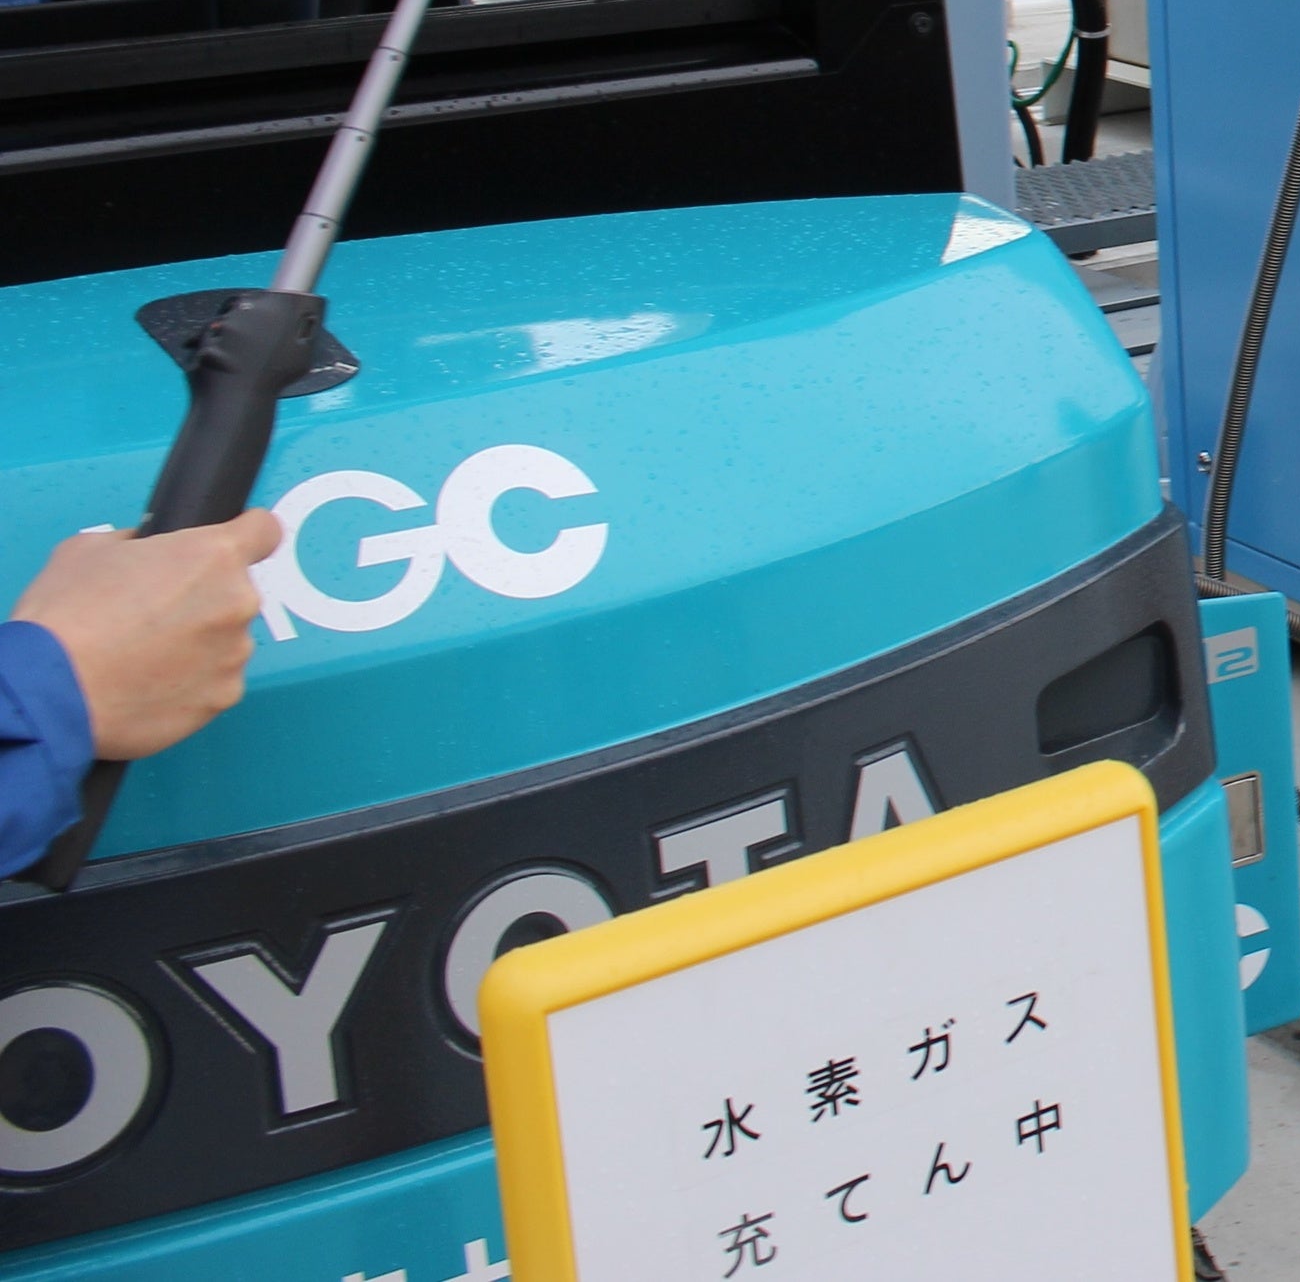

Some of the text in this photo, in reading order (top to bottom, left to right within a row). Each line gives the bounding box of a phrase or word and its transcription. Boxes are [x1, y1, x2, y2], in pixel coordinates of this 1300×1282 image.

[80, 444, 609, 642] GC
[702, 991, 1049, 1160] 水素ガス
[717, 1099, 1063, 1280] 充てん中
